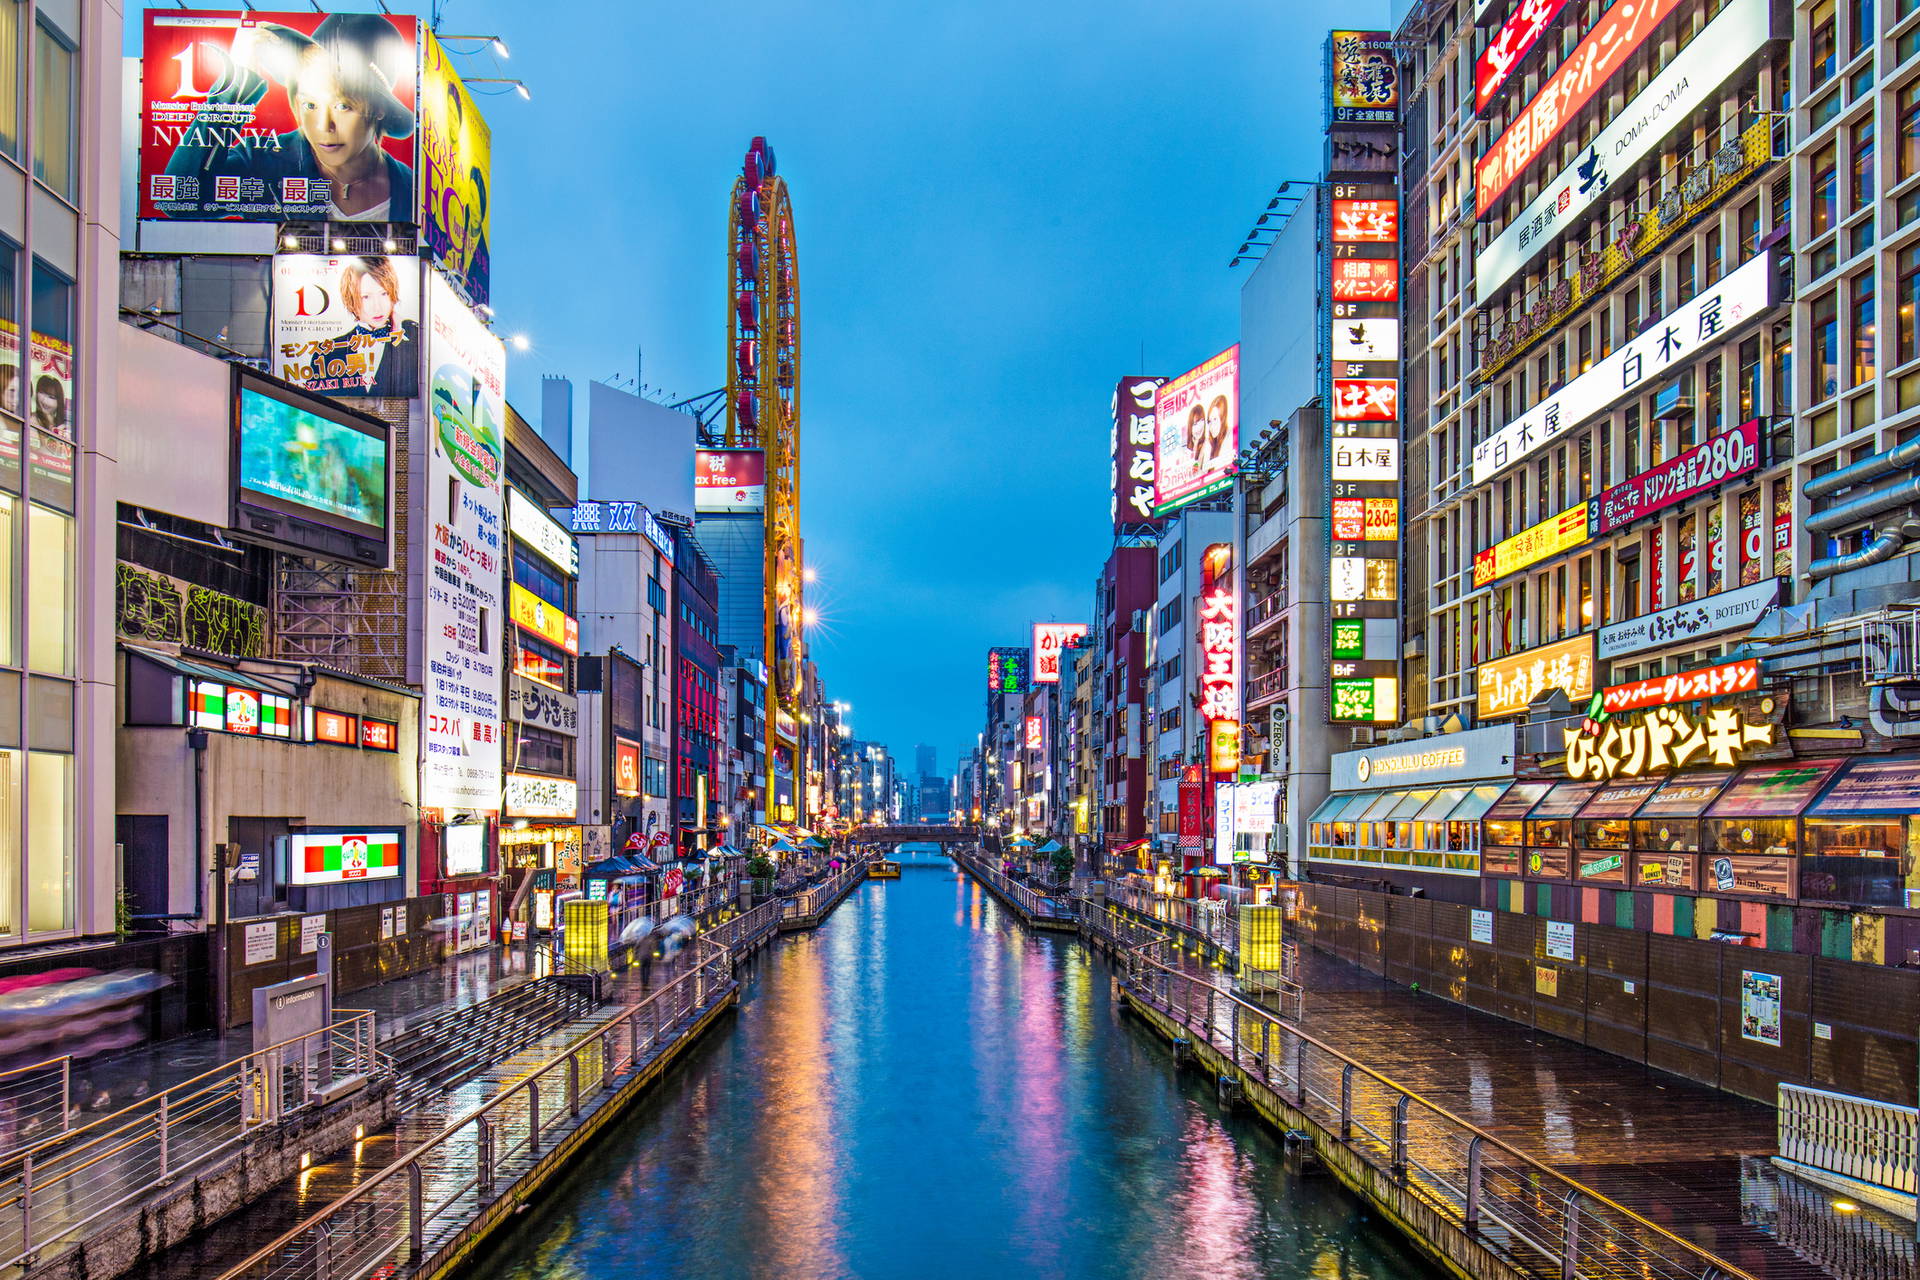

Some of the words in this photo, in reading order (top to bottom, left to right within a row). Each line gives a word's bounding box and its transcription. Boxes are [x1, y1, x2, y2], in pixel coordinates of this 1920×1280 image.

[1505, 0, 1658, 179] 相席ダイニン
[151, 100, 190, 111] Monster
[190, 101, 257, 112] Entertainment
[152, 112, 196, 122] DEEP
[196, 112, 257, 125] GROUP
[1615, 77, 1689, 156] DOMA-DOMA
[152, 126, 284, 151] NYANNYA
[151, 175, 200, 201] 最強
[215, 176, 265, 202] 最幸
[283, 177, 333, 203] 最高
[1335, 186, 1356, 198] 8F
[1335, 245, 1356, 257] 7F
[1343, 262, 1371, 279] 相席
[1334, 279, 1397, 298] ダイニング
[1335, 304, 1357, 317] 6F
[280, 329, 405, 359] モンスターグループ
[1623, 294, 1725, 390] 白木屋
[283, 351, 376, 382] No.1の男!
[1346, 364, 1364, 376] 5F
[342, 375, 378, 389] RUKA
[1335, 423, 1357, 436] 4F
[1476, 445, 1489, 463] 4F
[1494, 401, 1562, 470] 白木屋
[1336, 445, 1393, 468] 白木屋
[712, 474, 737, 485] Free
[1335, 484, 1357, 496] 3F
[1367, 509, 1396, 528] 280円
[1335, 543, 1356, 556] 2F
[1335, 603, 1356, 616] 1F
[1715, 599, 1760, 620] BOTEJYU
[1602, 633, 1617, 646] 大阪
[1617, 625, 1646, 642] お好み焼
[1202, 589, 1234, 719] 大阪王将
[1480, 667, 1496, 687] 2F
[1490, 653, 1575, 712] 山内農場
[1604, 665, 1756, 708] ハンバーグレストラン
[1334, 703, 1373, 719] ドンキー
[326, 718, 339, 738] 酒
[362, 725, 389, 745] たばこ
[1273, 721, 1283, 747] ZERO
[1563, 706, 1773, 781] びっくりドンキー
[1373, 753, 1421, 775] HONOLULU
[1421, 747, 1466, 769] COFFEE
[1668, 859, 1682, 867] KEEP
[285, 988, 315, 1006] information
